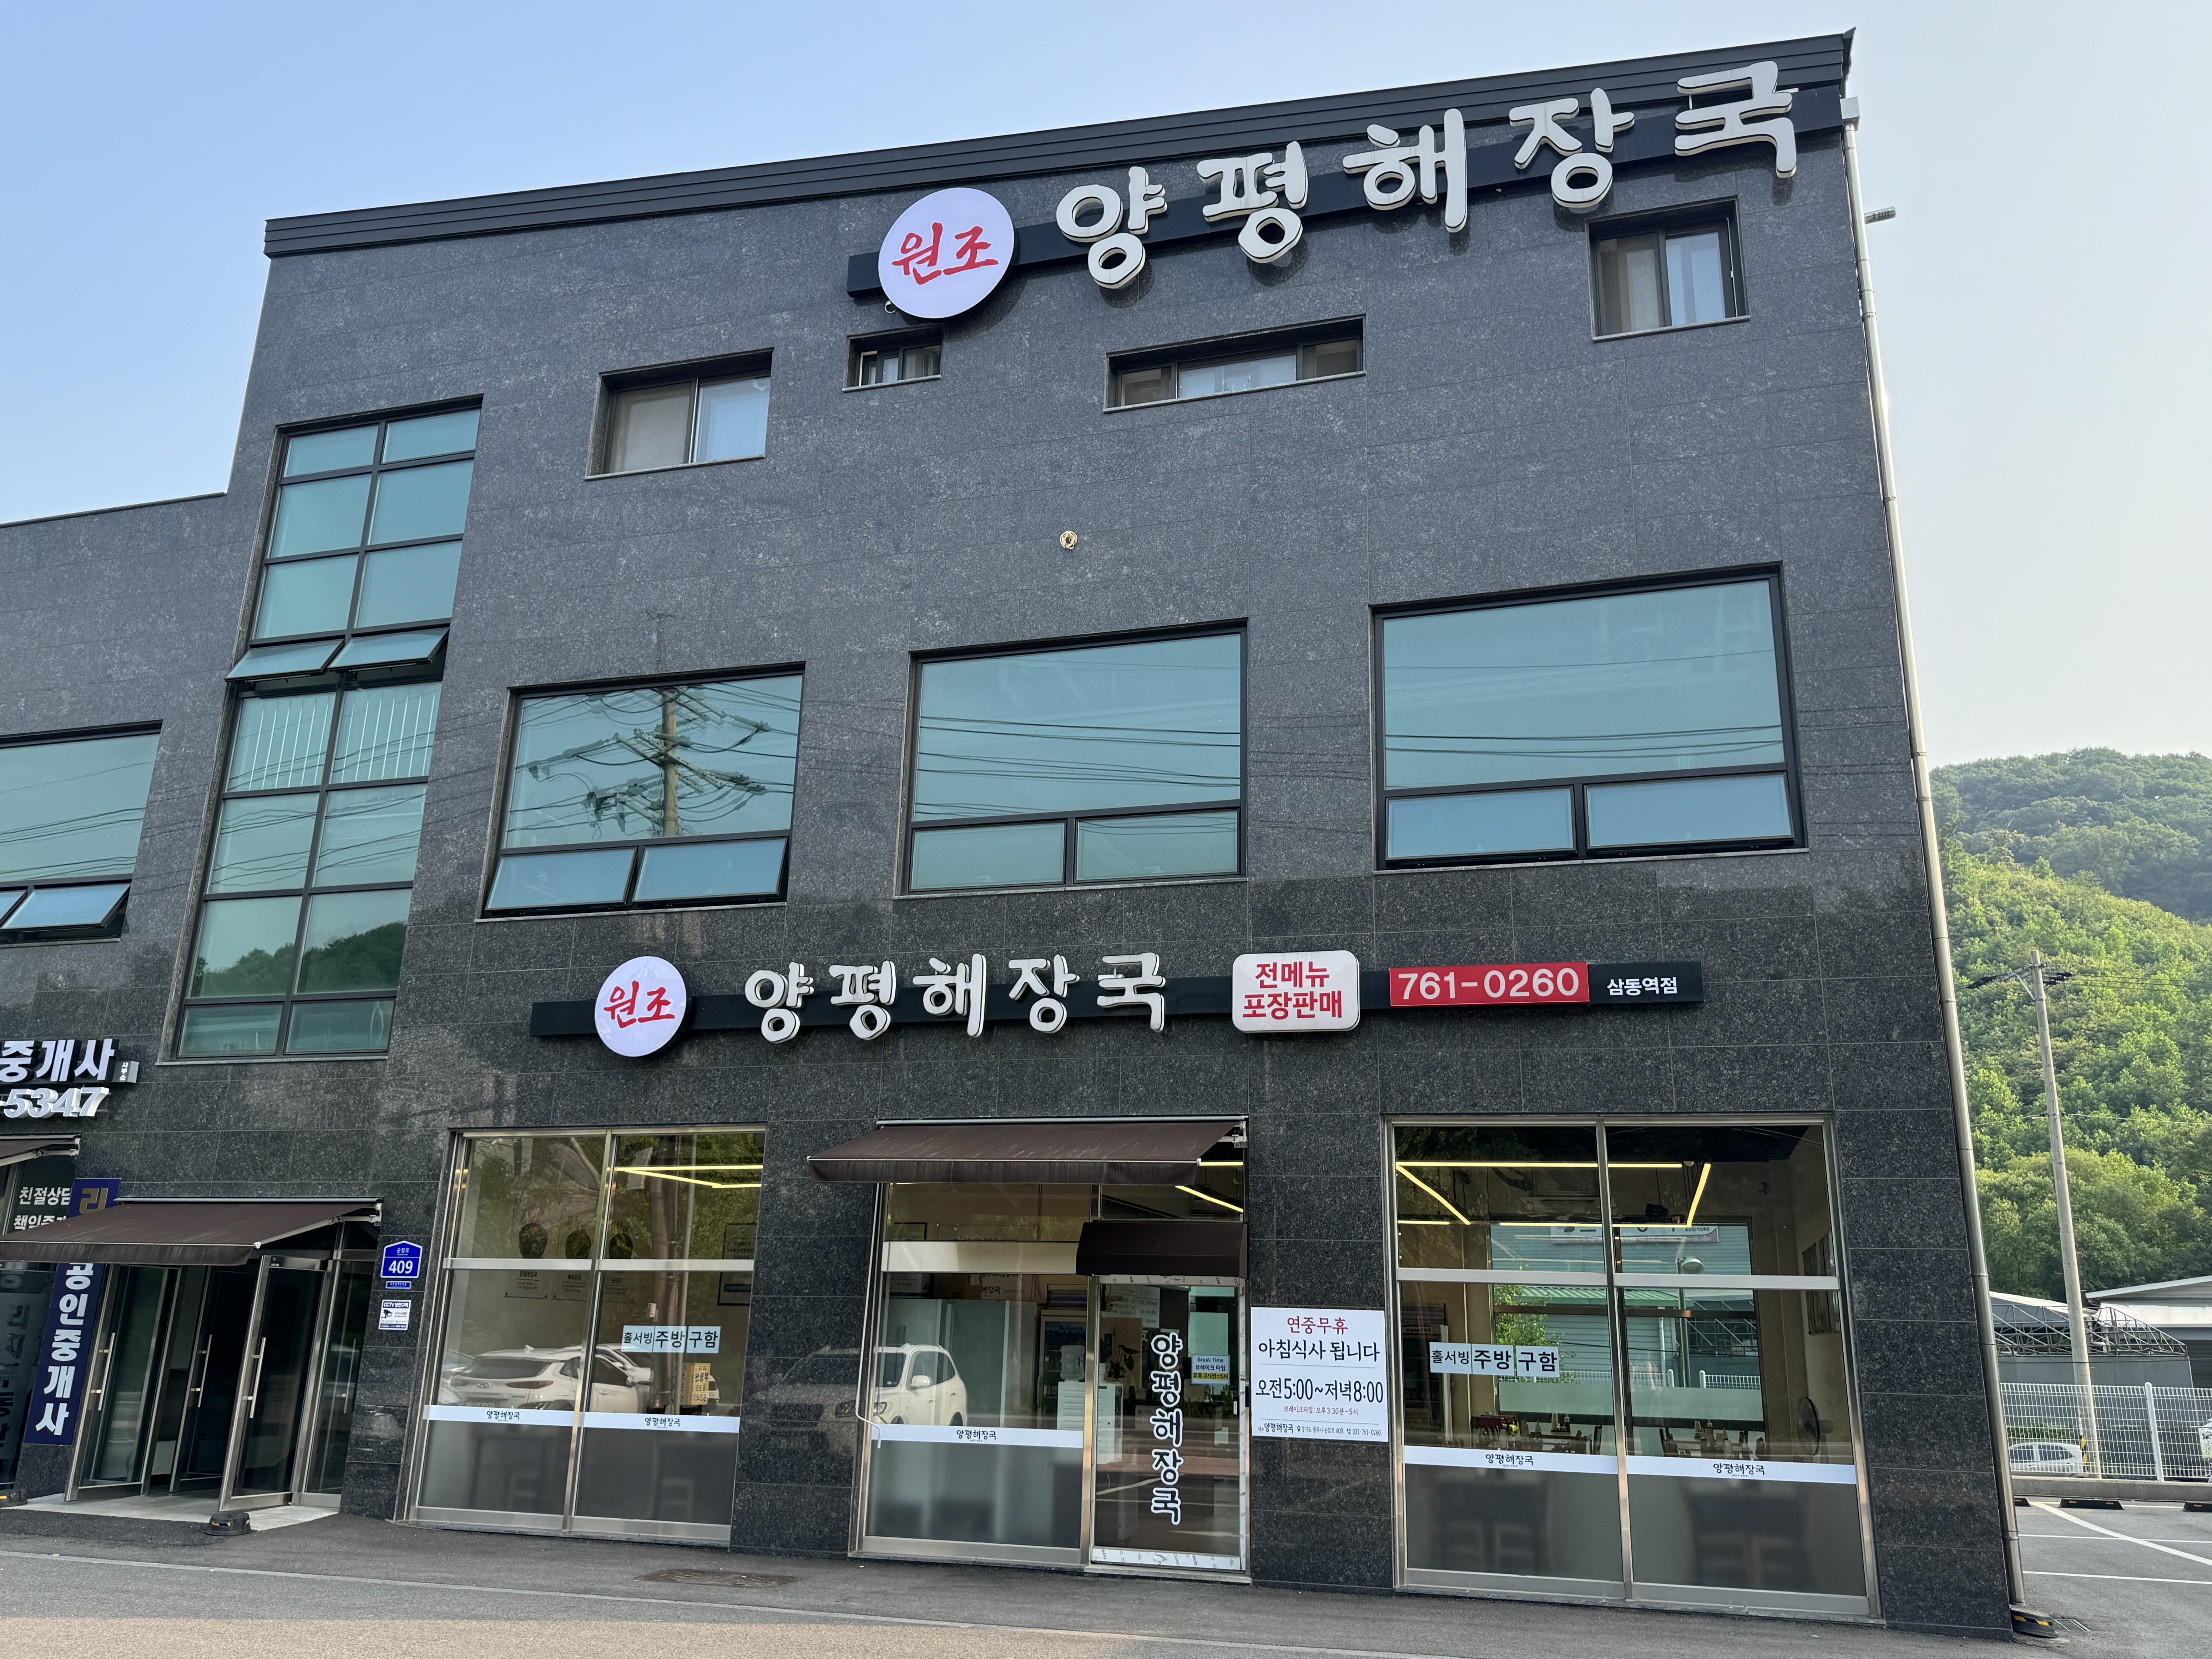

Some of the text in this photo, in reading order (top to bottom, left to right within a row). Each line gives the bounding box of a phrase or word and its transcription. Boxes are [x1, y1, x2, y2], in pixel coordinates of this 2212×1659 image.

[891, 60, 1798, 289] 원조 양평해장국
[1255, 962, 1329, 988] 전메뉴
[1398, 967, 1579, 1000] 761-0260
[1607, 977, 1677, 996] 삼동역점
[603, 953, 1166, 1043] 원조 양평해장국
[1242, 990, 1342, 1020] 포장판매
[0, 1038, 115, 1082] 중개사
[388, 1260, 413, 1274] 409
[1287, 1316, 1348, 1335] 연중무휴
[35, 1263, 93, 1436] 공인중개사
[624, 1331, 718, 1348] 홀서빙 주방 구함
[1259, 1339, 1380, 1362] 아침식사 됩니다
[1431, 1350, 1557, 1372] 홀서빙 주방 구함
[957, 1430, 996, 1440] 양평해장국
[1150, 1332, 1183, 1525] 양평해장국
[1486, 1453, 1533, 1466] 양평해장국
[1713, 1463, 1764, 1475] 양평해장국
